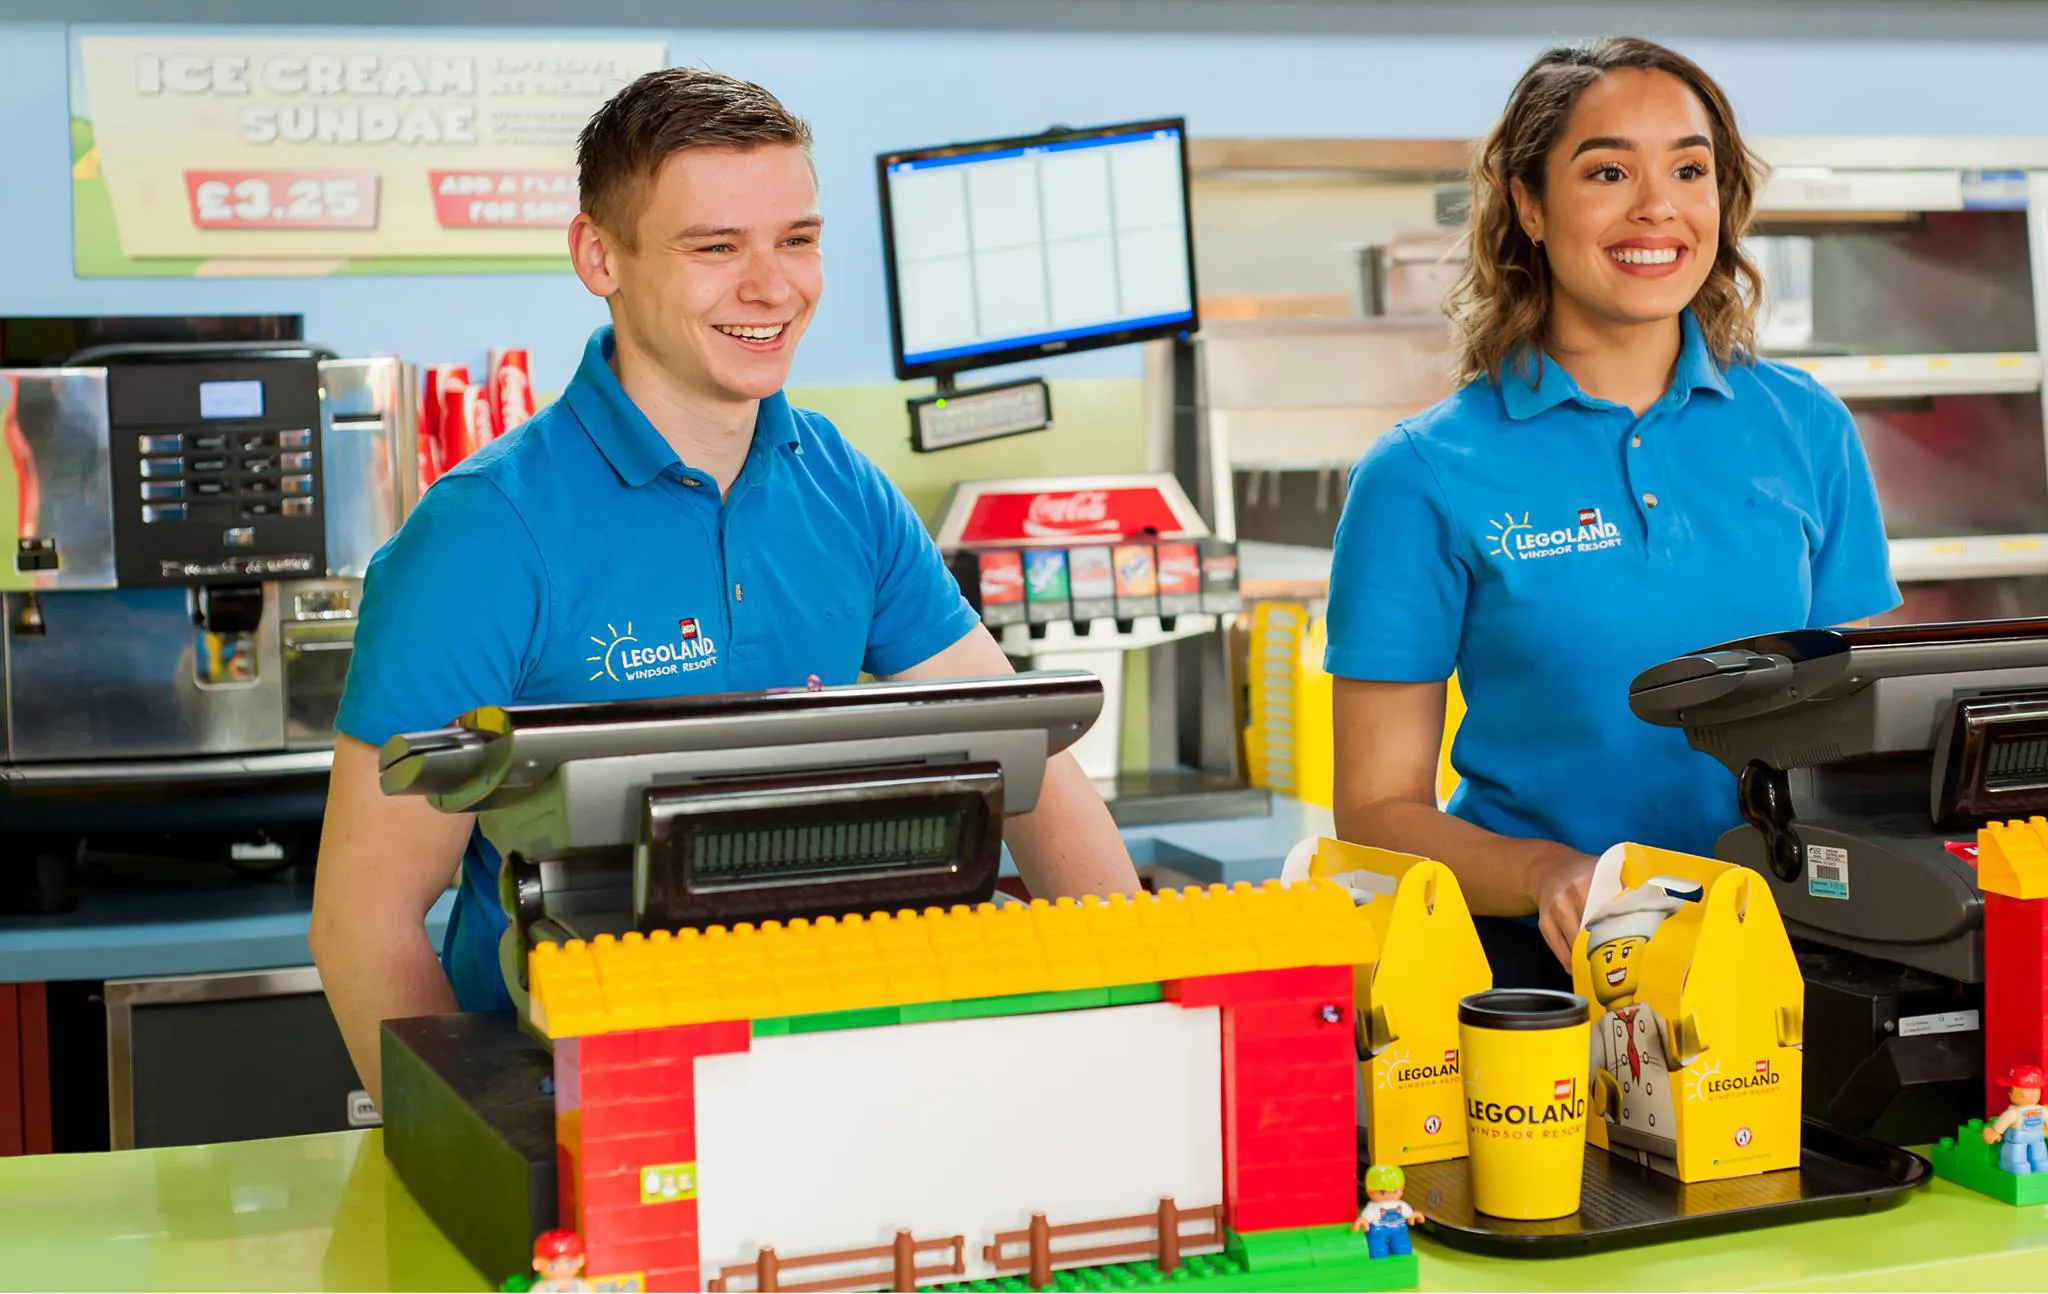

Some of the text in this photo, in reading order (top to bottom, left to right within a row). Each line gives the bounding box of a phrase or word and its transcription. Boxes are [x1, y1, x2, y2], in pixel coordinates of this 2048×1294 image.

[136, 54, 475, 95] ICE CREAM
[240, 103, 475, 143] SUNDAE
[197, 179, 360, 219] £3.25
[498, 175, 517, 195] A
[1515, 508, 1617, 549] LEGOLAND
[1519, 538, 1622, 560] WINDSOR RESORT
[621, 618, 714, 668] LEGOLAND
[625, 656, 718, 680] WINDSOR RESORT
[1398, 1049, 1459, 1082] LEGOLAN
[1708, 1060, 1780, 1092] LEGOLAND
[1468, 1078, 1585, 1124] LEGOLAND
